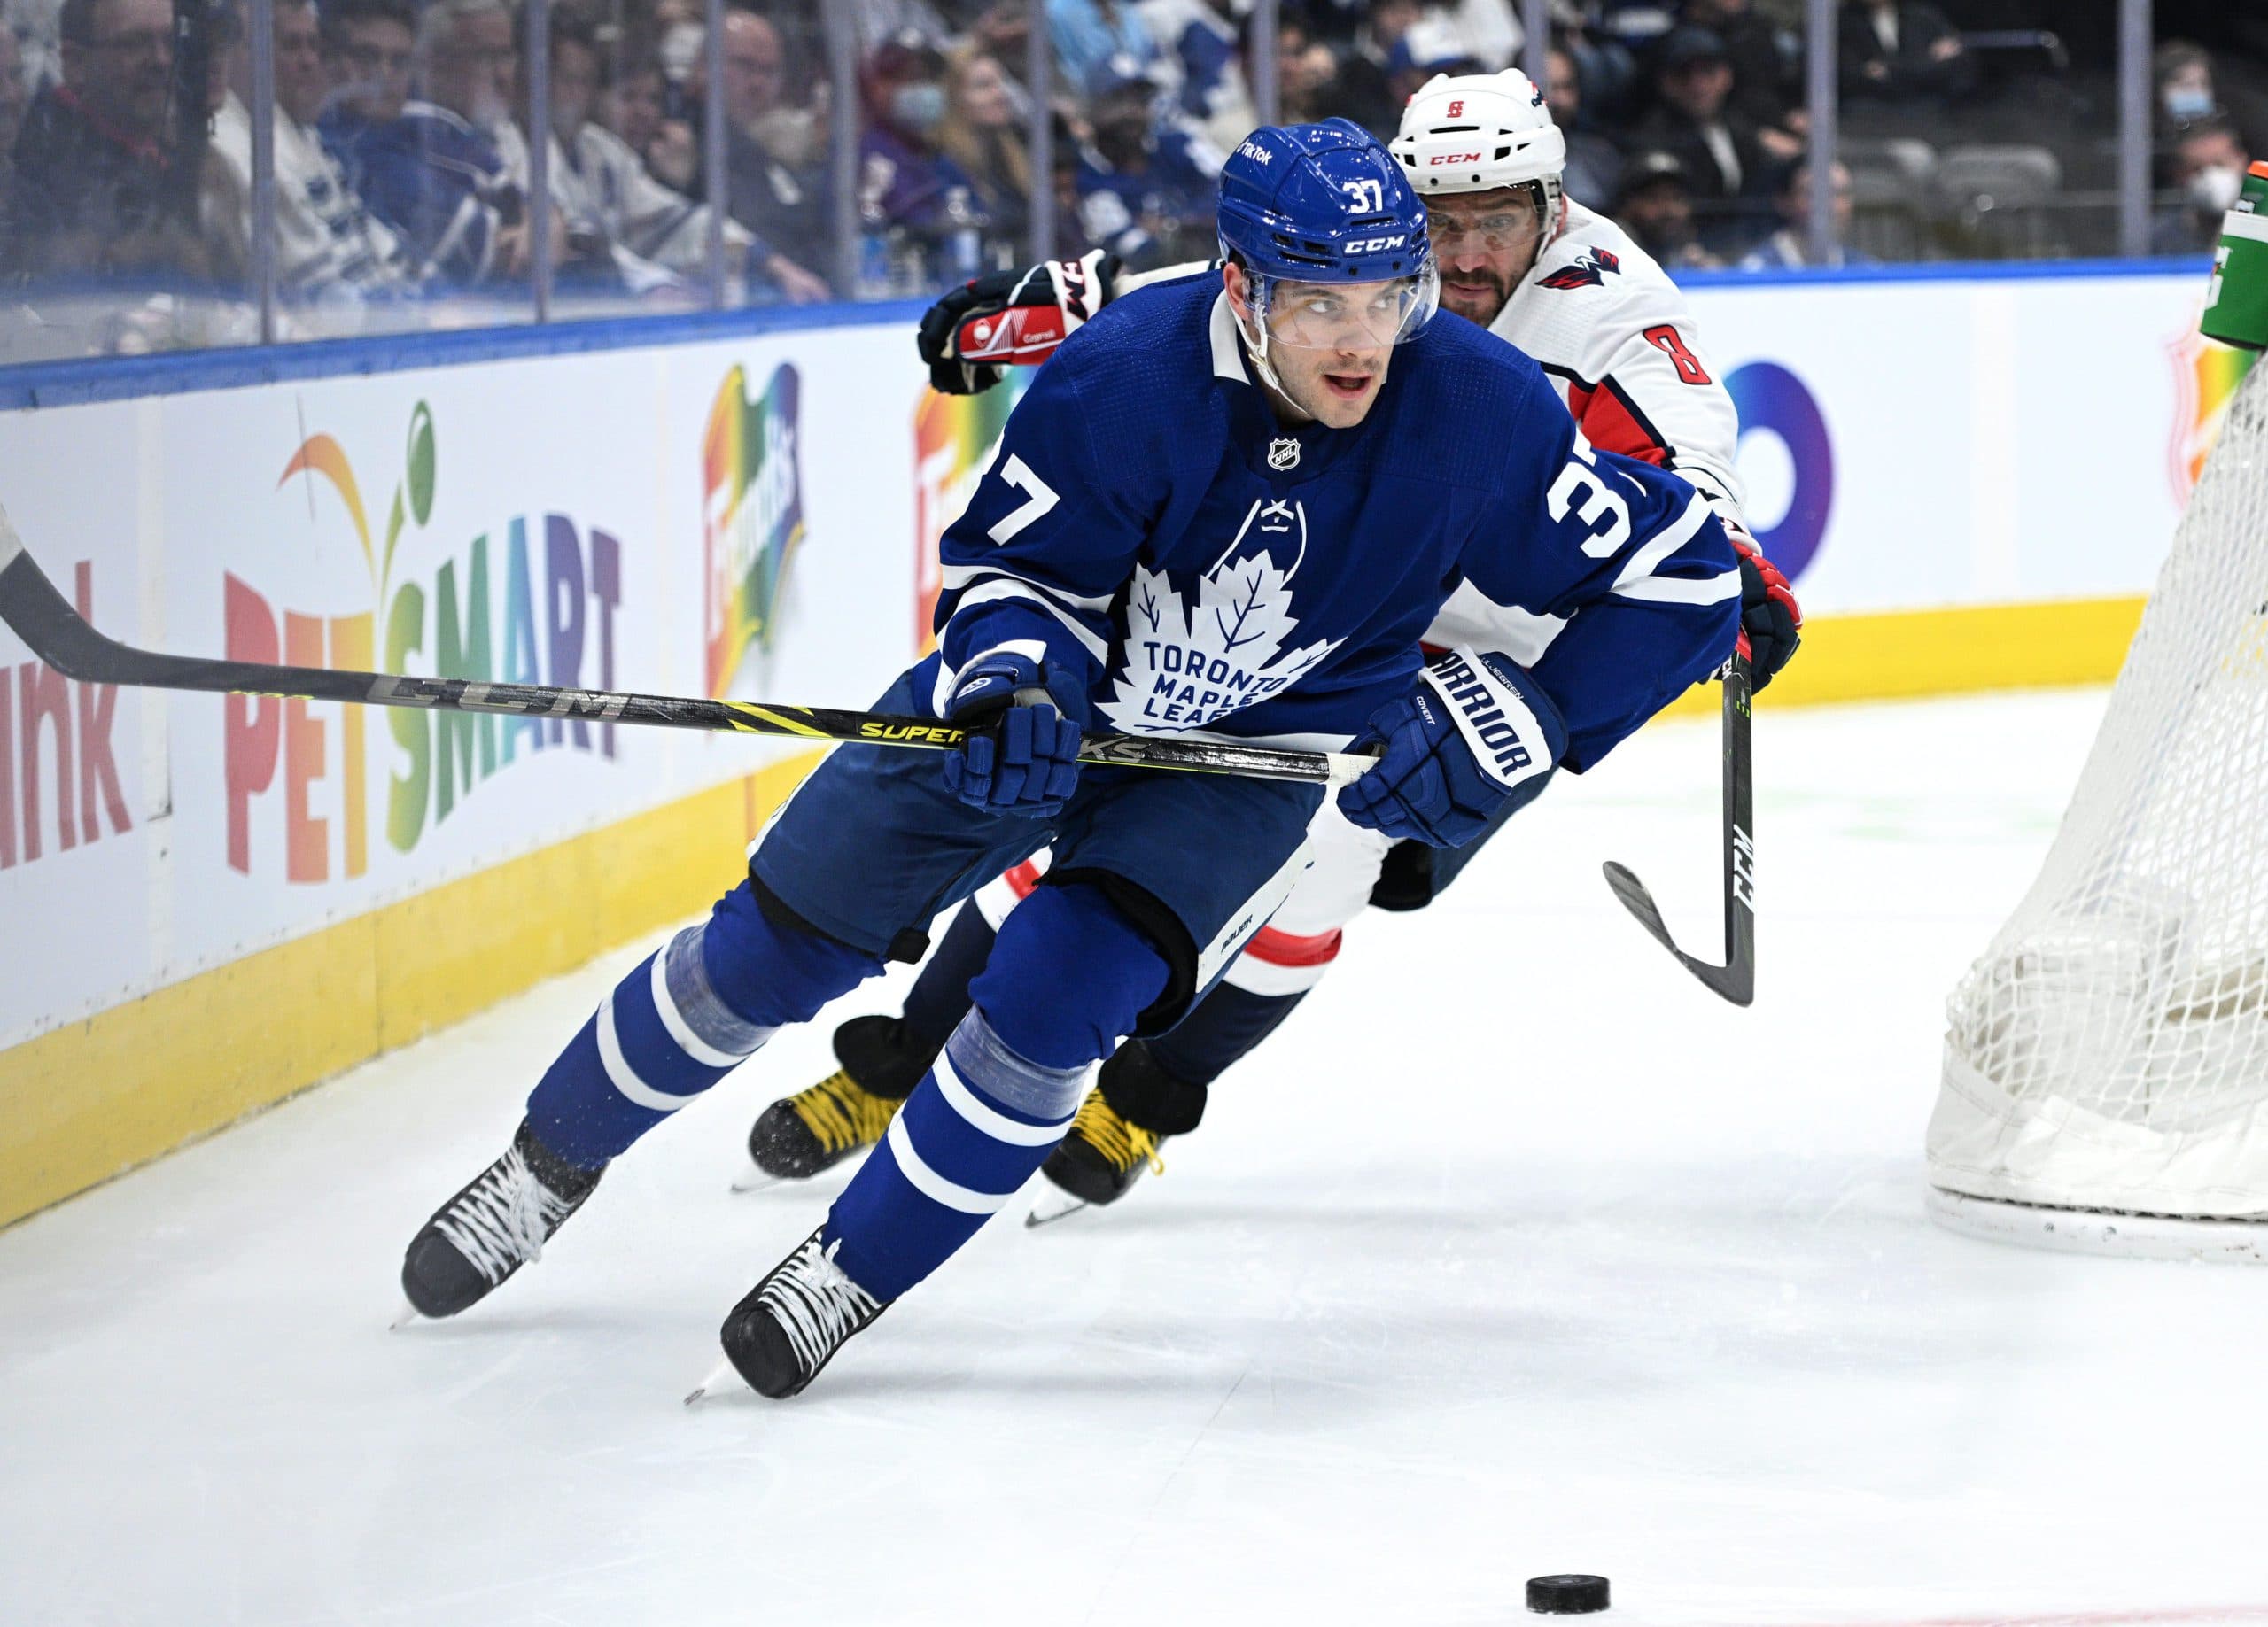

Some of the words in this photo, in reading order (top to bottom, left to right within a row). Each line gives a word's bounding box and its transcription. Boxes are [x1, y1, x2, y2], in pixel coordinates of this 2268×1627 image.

[1446, 100, 1464, 119] 8
[1241, 141, 1273, 166] TikTok
[1430, 152, 1481, 166] CCM
[1342, 179, 1383, 214] 37
[1344, 235, 1406, 254] CCM
[1643, 323, 1713, 386] 8
[1274, 446, 1295, 465] NHL
[982, 427, 1061, 546] 7
[1547, 430, 1647, 559] 3
[1143, 641, 1289, 693] TORONTO
[1153, 673, 1259, 709] MAPLE
[1142, 698, 1247, 724] LEAF
[1416, 695, 1436, 726] COVERT
[1426, 652, 1533, 778] ARRIOR
[1733, 823, 1755, 914] CCM
